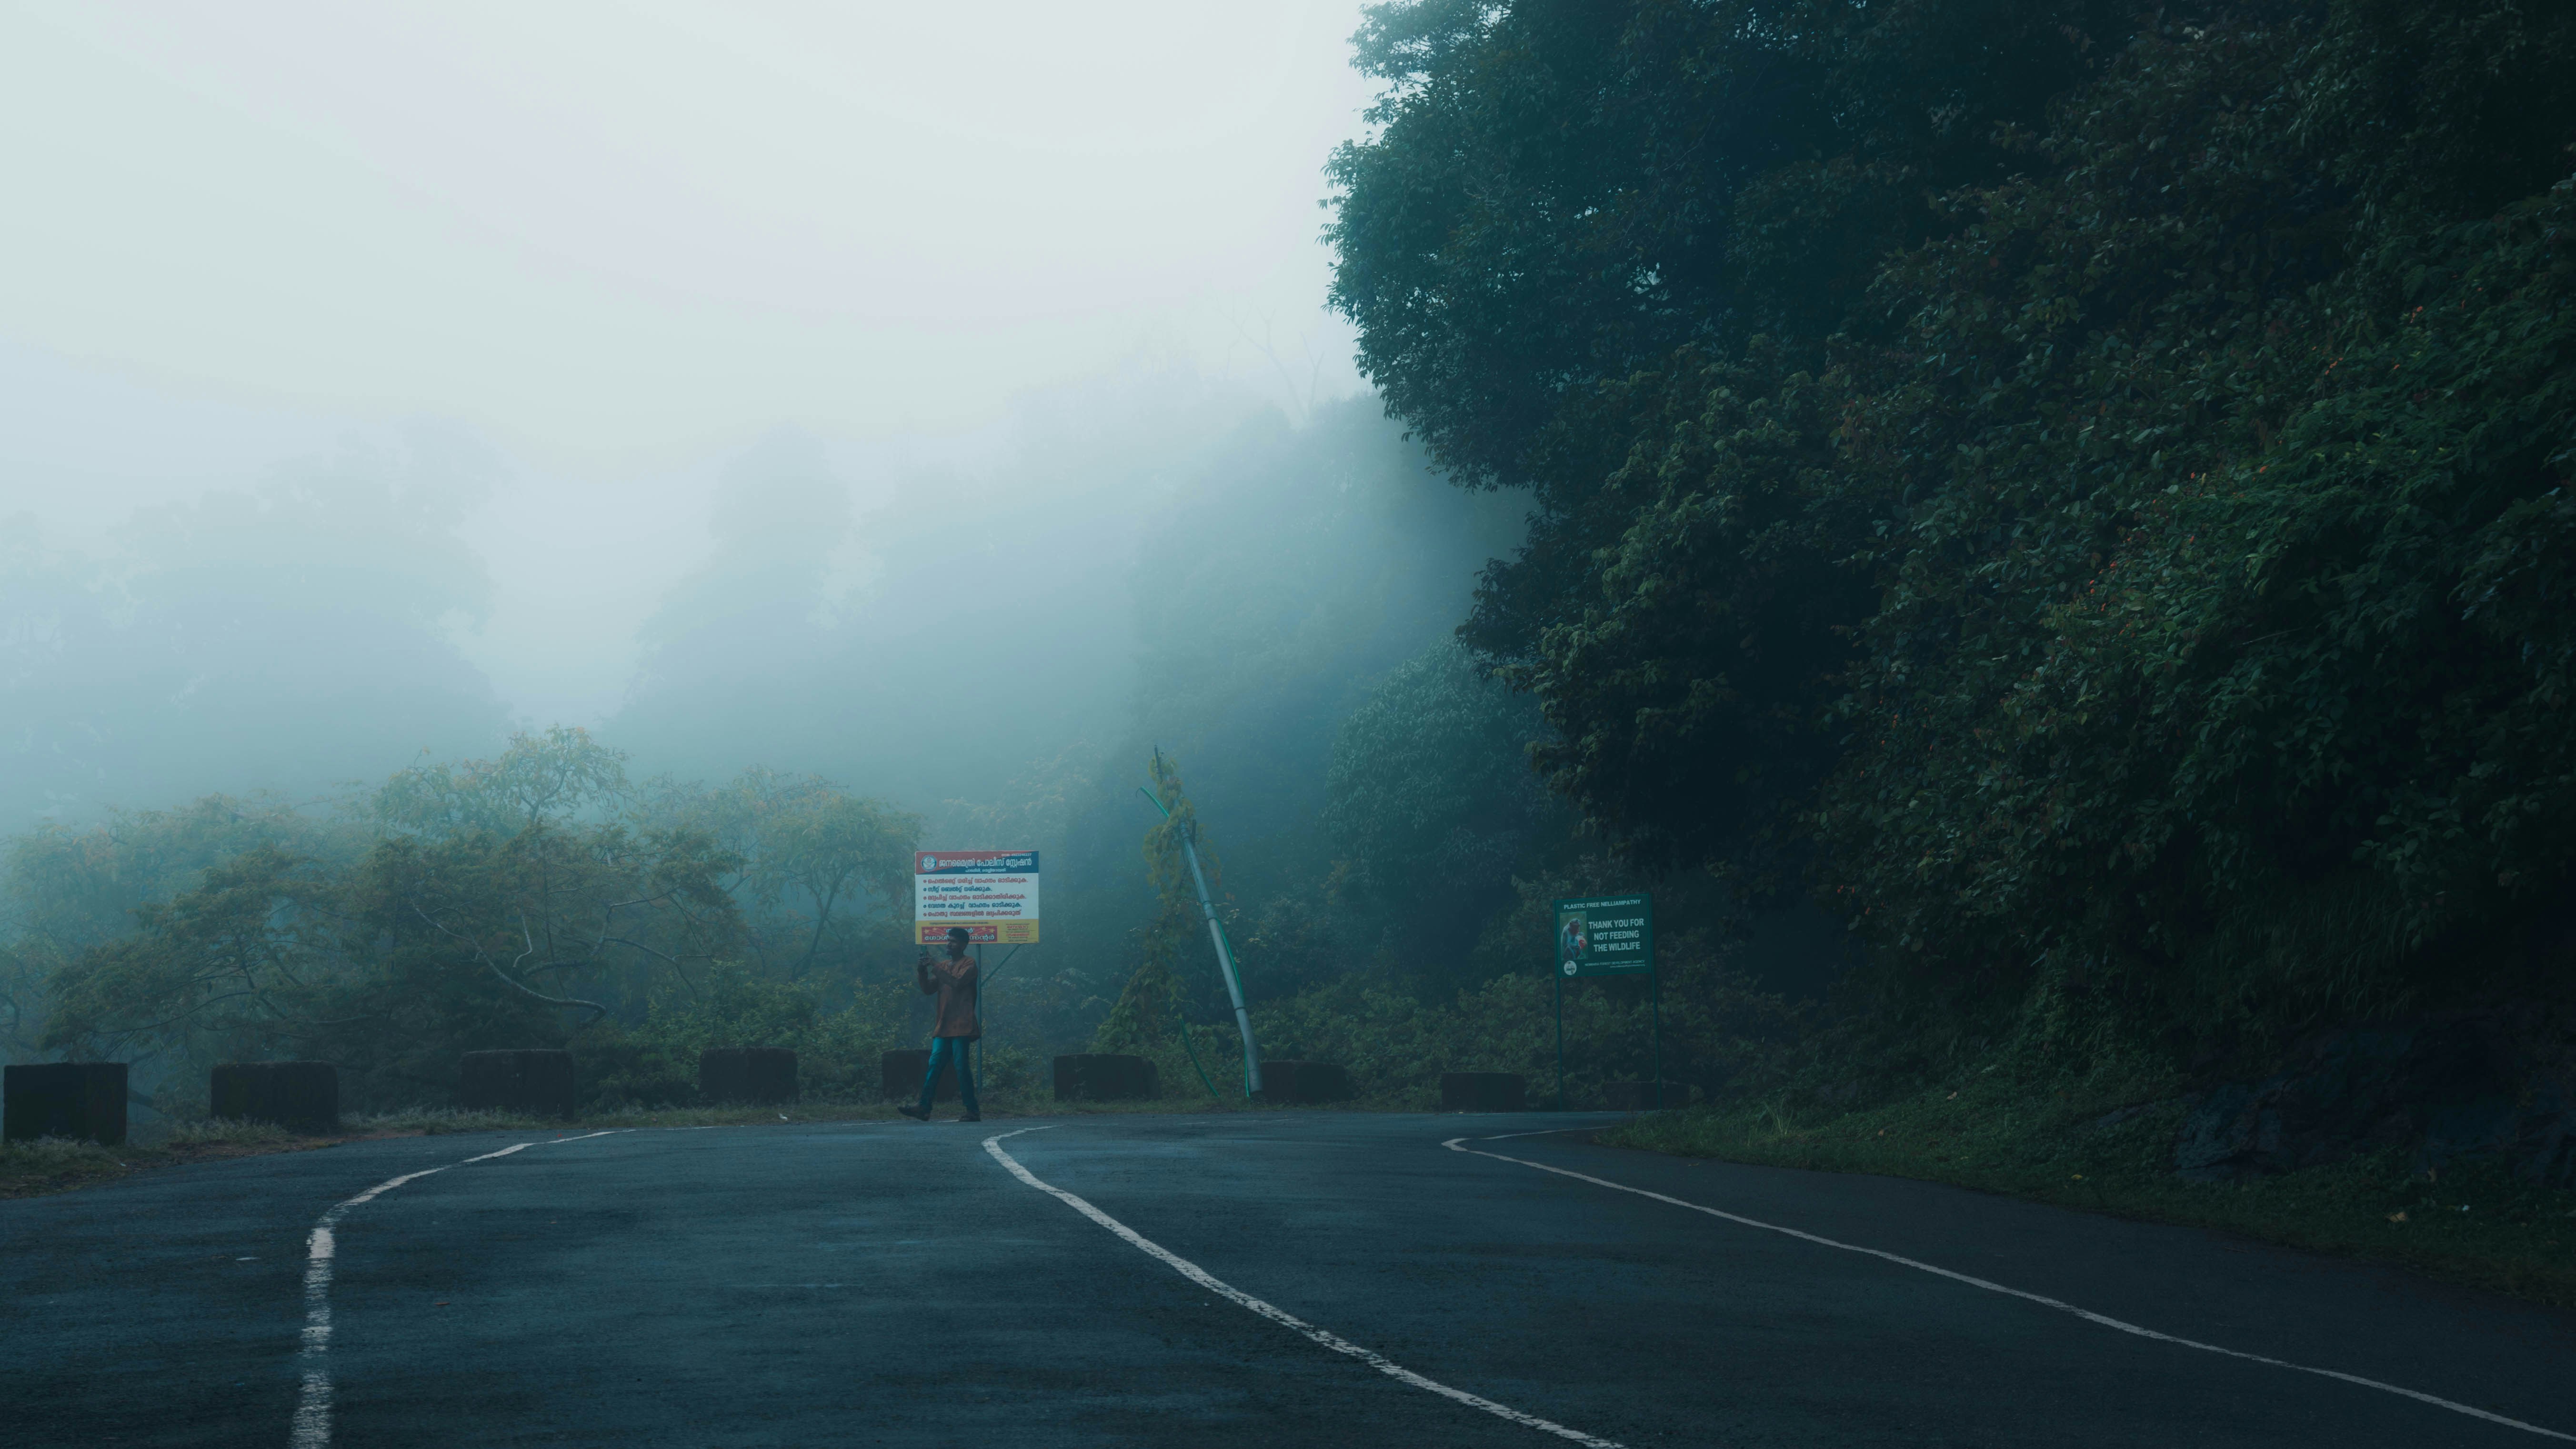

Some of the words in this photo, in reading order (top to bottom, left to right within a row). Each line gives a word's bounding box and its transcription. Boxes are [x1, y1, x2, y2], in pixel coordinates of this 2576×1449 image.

[939, 858, 975, 868] ജനമൈത്രി
[1006, 858, 1032, 869] സ്റ്റേഷൻ
[1588, 920, 1613, 929] THANK
[1614, 919, 1628, 928] YOU
[1630, 918, 1644, 927] FOR
[1594, 932, 1608, 940] NOT
[1609, 930, 1639, 939] FEEDING
[1594, 944, 1607, 952] THE
[1608, 942, 1641, 951] WILDLIFE
